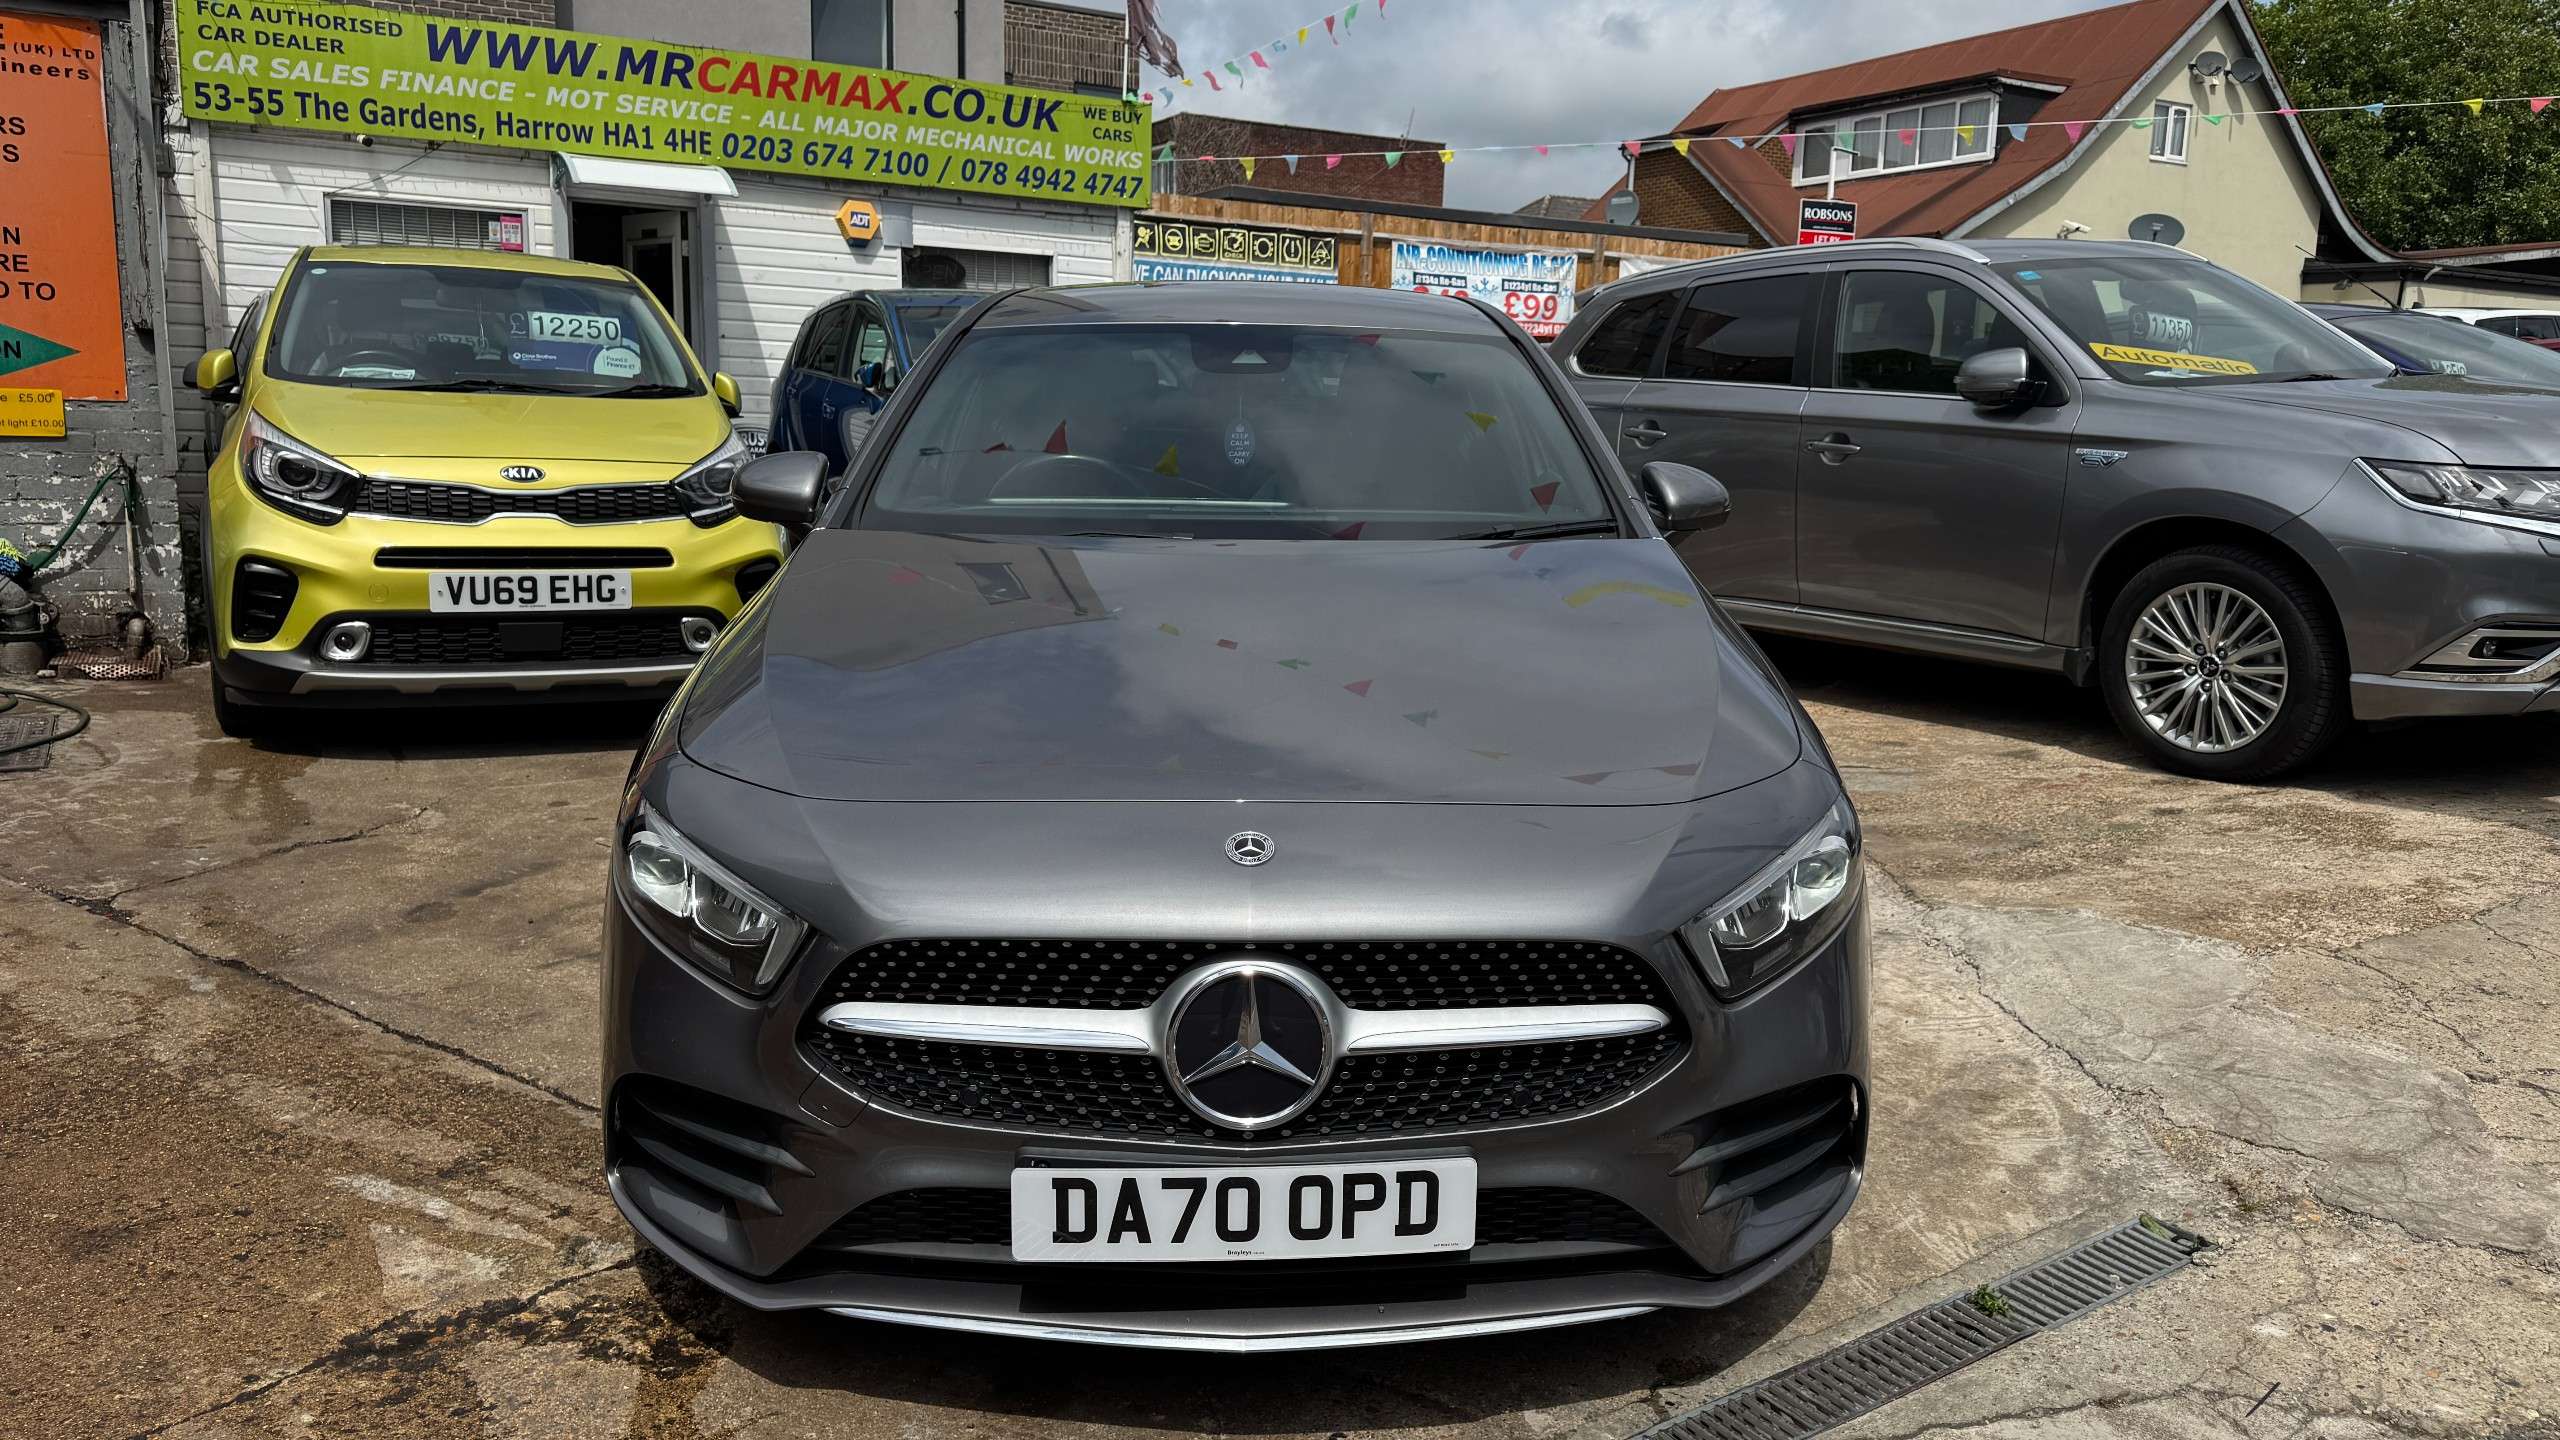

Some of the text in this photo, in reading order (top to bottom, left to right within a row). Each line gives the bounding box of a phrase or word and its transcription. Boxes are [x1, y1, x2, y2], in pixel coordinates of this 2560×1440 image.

[197, 1, 403, 38] FCA AUTHORISED
[13, 41, 95, 60] (UK) LTD
[197, 24, 345, 54] CAR DEALER
[426, 23, 1064, 133] WWW.MRCARMAX.CO.UK
[192, 50, 259, 77] CAR
[270, 57, 369, 87] SALES
[380, 69, 516, 102] FINANCE
[545, 86, 609, 111] MOT
[615, 94, 734, 125] SERVICE
[758, 110, 805, 132] ALL
[813, 115, 898, 143] MAJOR
[905, 126, 1056, 160] MECHANICAL
[1064, 144, 1143, 170] WORKS
[1083, 106, 1143, 125] WE BUY
[194, 81, 1143, 199] 53-55 The Gardens, Harrow HA1 4HE 0203 674 7100 / 078 4942 4747
[1092, 127, 1132, 143] CARS
[851, 213, 870, 227] ADT
[1804, 207, 1853, 222] ROBSONS
[1813, 234, 1829, 244] LET
[18, 281, 56, 301] TO
[1504, 291, 1558, 321] £99
[533, 315, 620, 341] 12250
[2151, 316, 2193, 344] 11350
[2102, 346, 2253, 374] Automatic
[31, 419, 64, 428] £10.00
[508, 467, 540, 479] KIA
[445, 574, 616, 606] VU69 EHG
[1051, 1169, 1440, 1244] DA70 OPD
